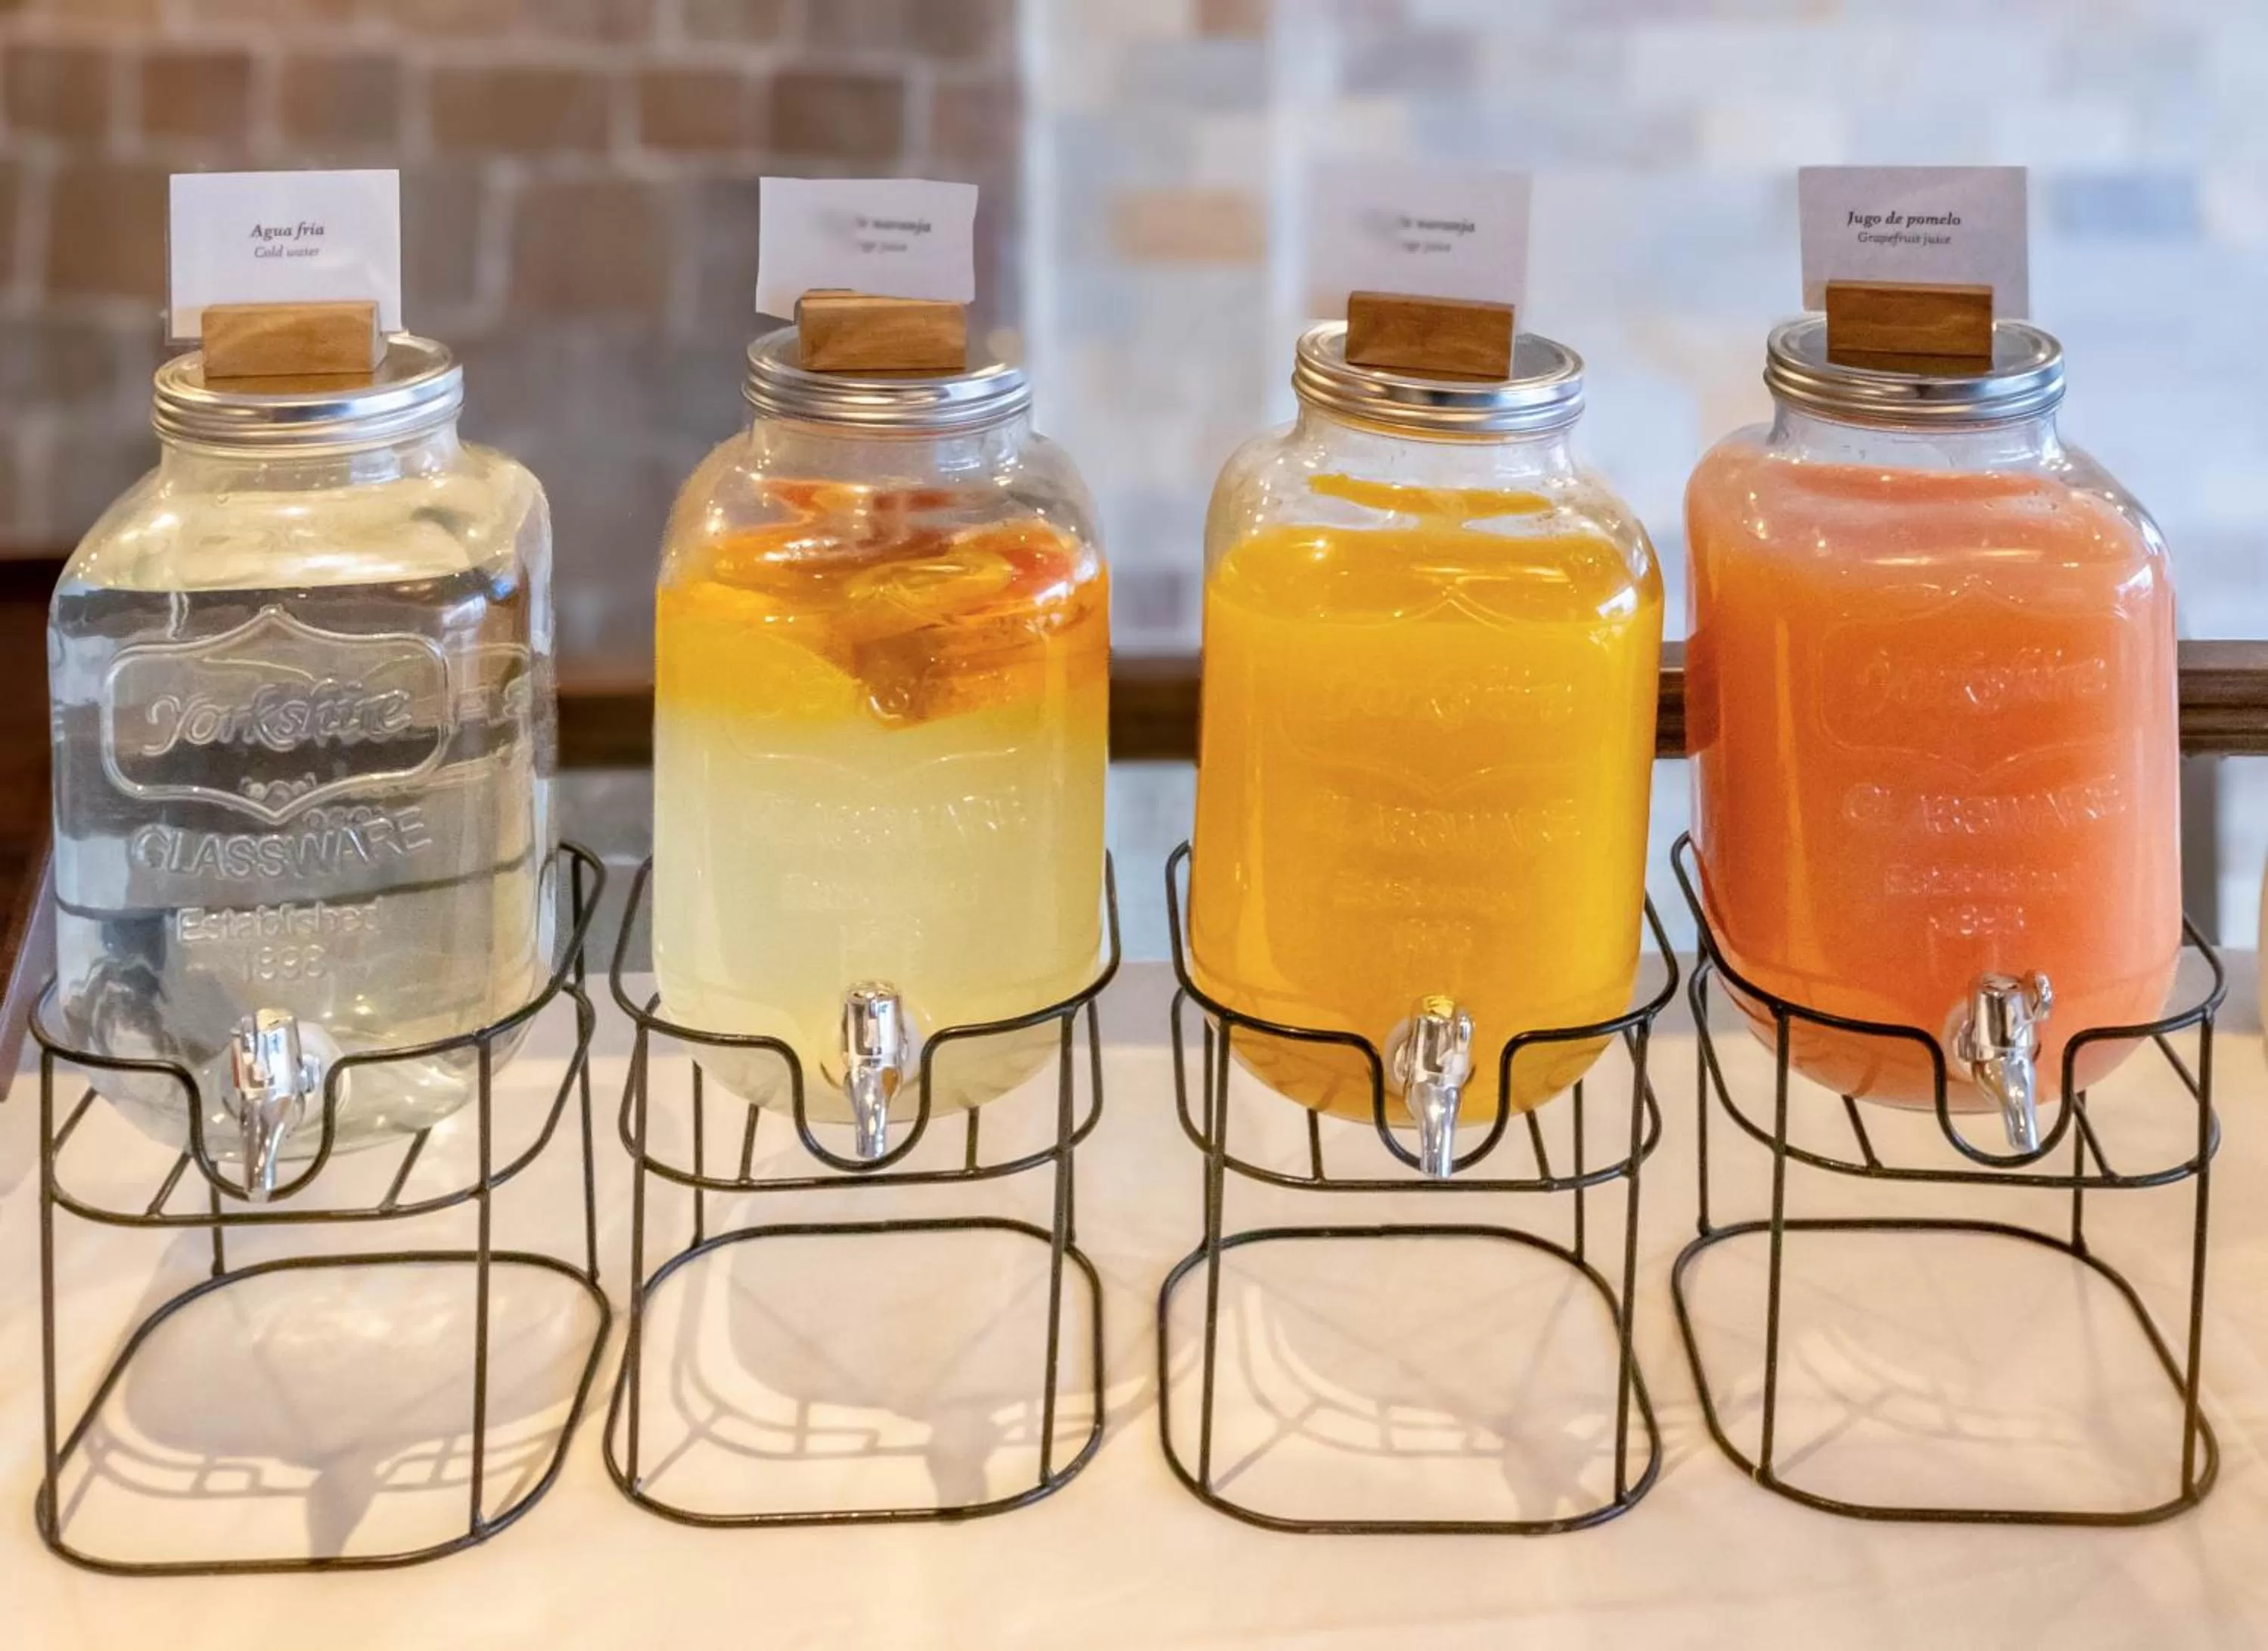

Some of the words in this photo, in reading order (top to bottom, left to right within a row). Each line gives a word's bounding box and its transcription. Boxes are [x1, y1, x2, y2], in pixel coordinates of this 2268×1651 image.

[1847, 210, 1882, 228] Jugo
[1885, 210, 1903, 225] de
[1906, 212, 1962, 228] pomelo
[250, 224, 293, 241] Agua
[1857, 231, 1920, 247] Grapefruit
[1922, 231, 1952, 247] juice
[254, 244, 284, 258] Cold
[287, 247, 320, 257] water
[132, 805, 433, 879] GLASSWARE
